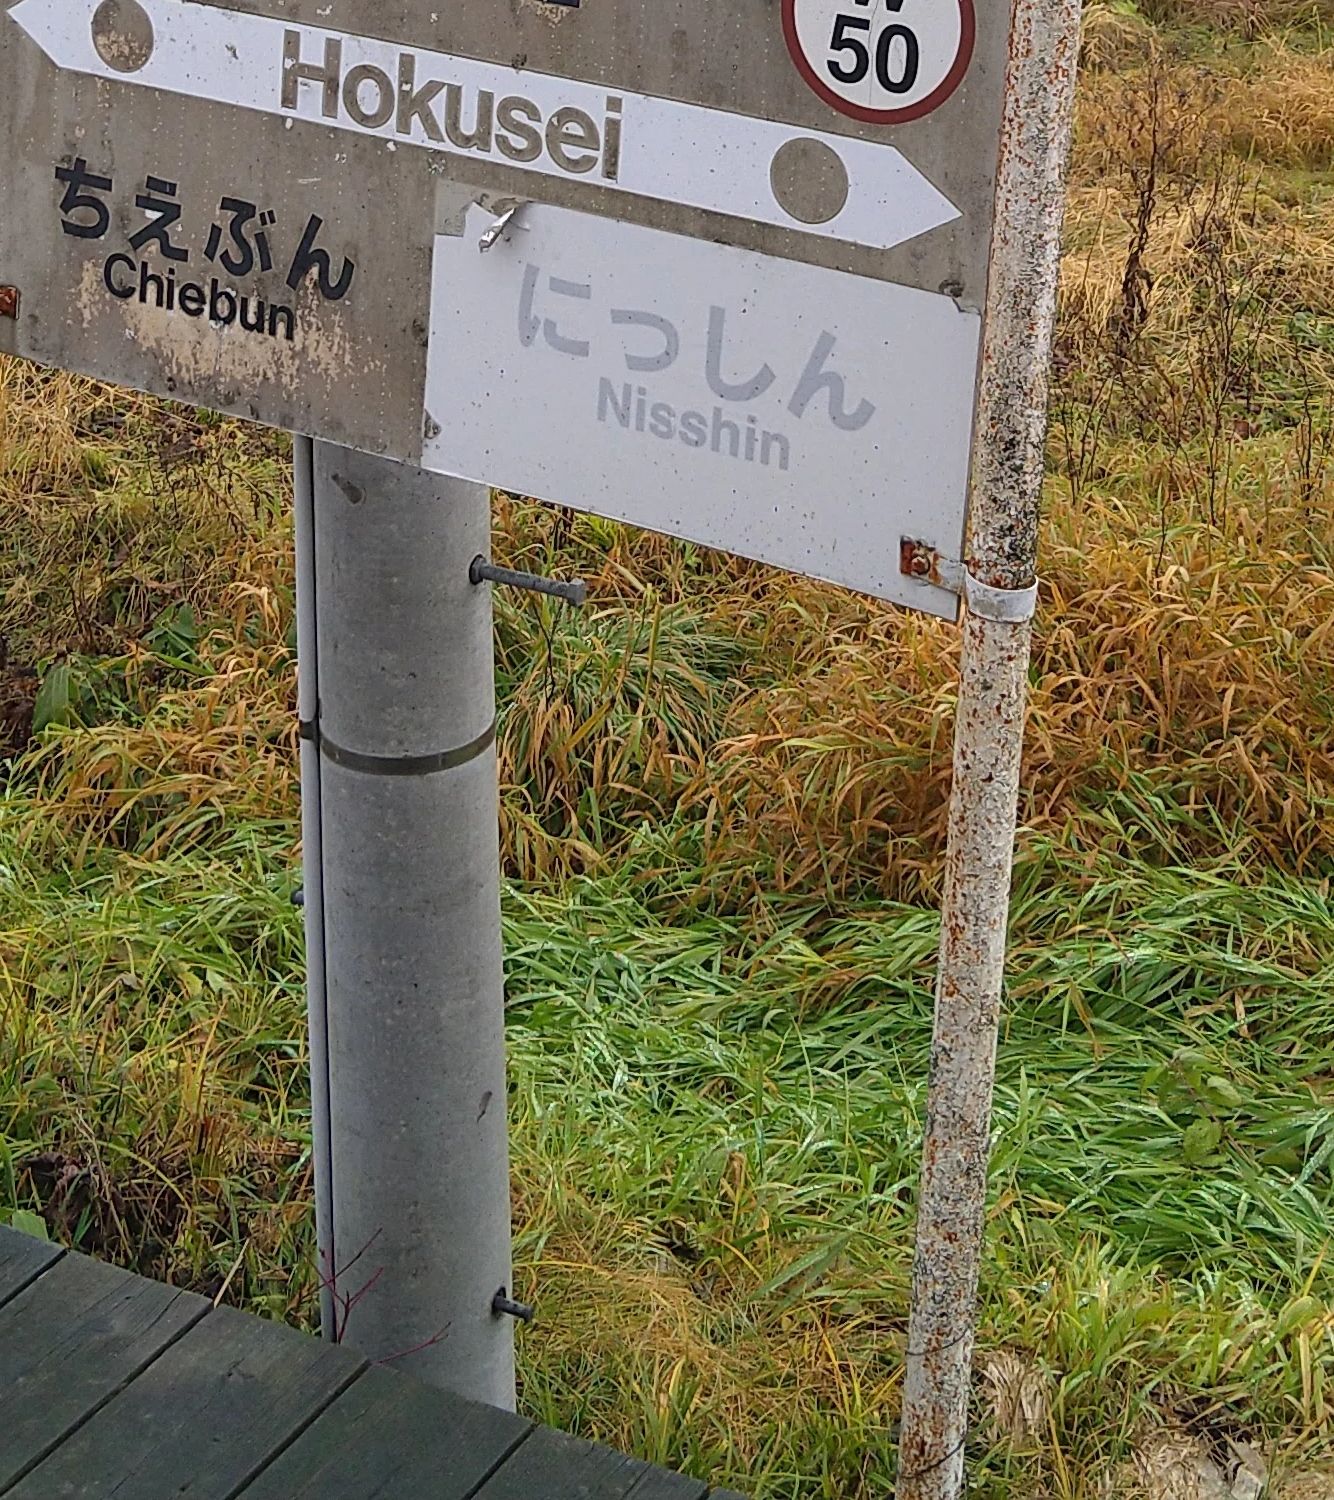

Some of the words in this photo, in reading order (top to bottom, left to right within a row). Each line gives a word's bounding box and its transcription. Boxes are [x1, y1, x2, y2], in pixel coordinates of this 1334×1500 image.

[280, 29, 624, 182] Hokusei
[827, 14, 920, 94] 50
[54, 157, 356, 301] ちえぶん
[103, 252, 295, 341] Chiebun
[517, 263, 876, 432] にっしん
[596, 376, 790, 471] Nisshin
